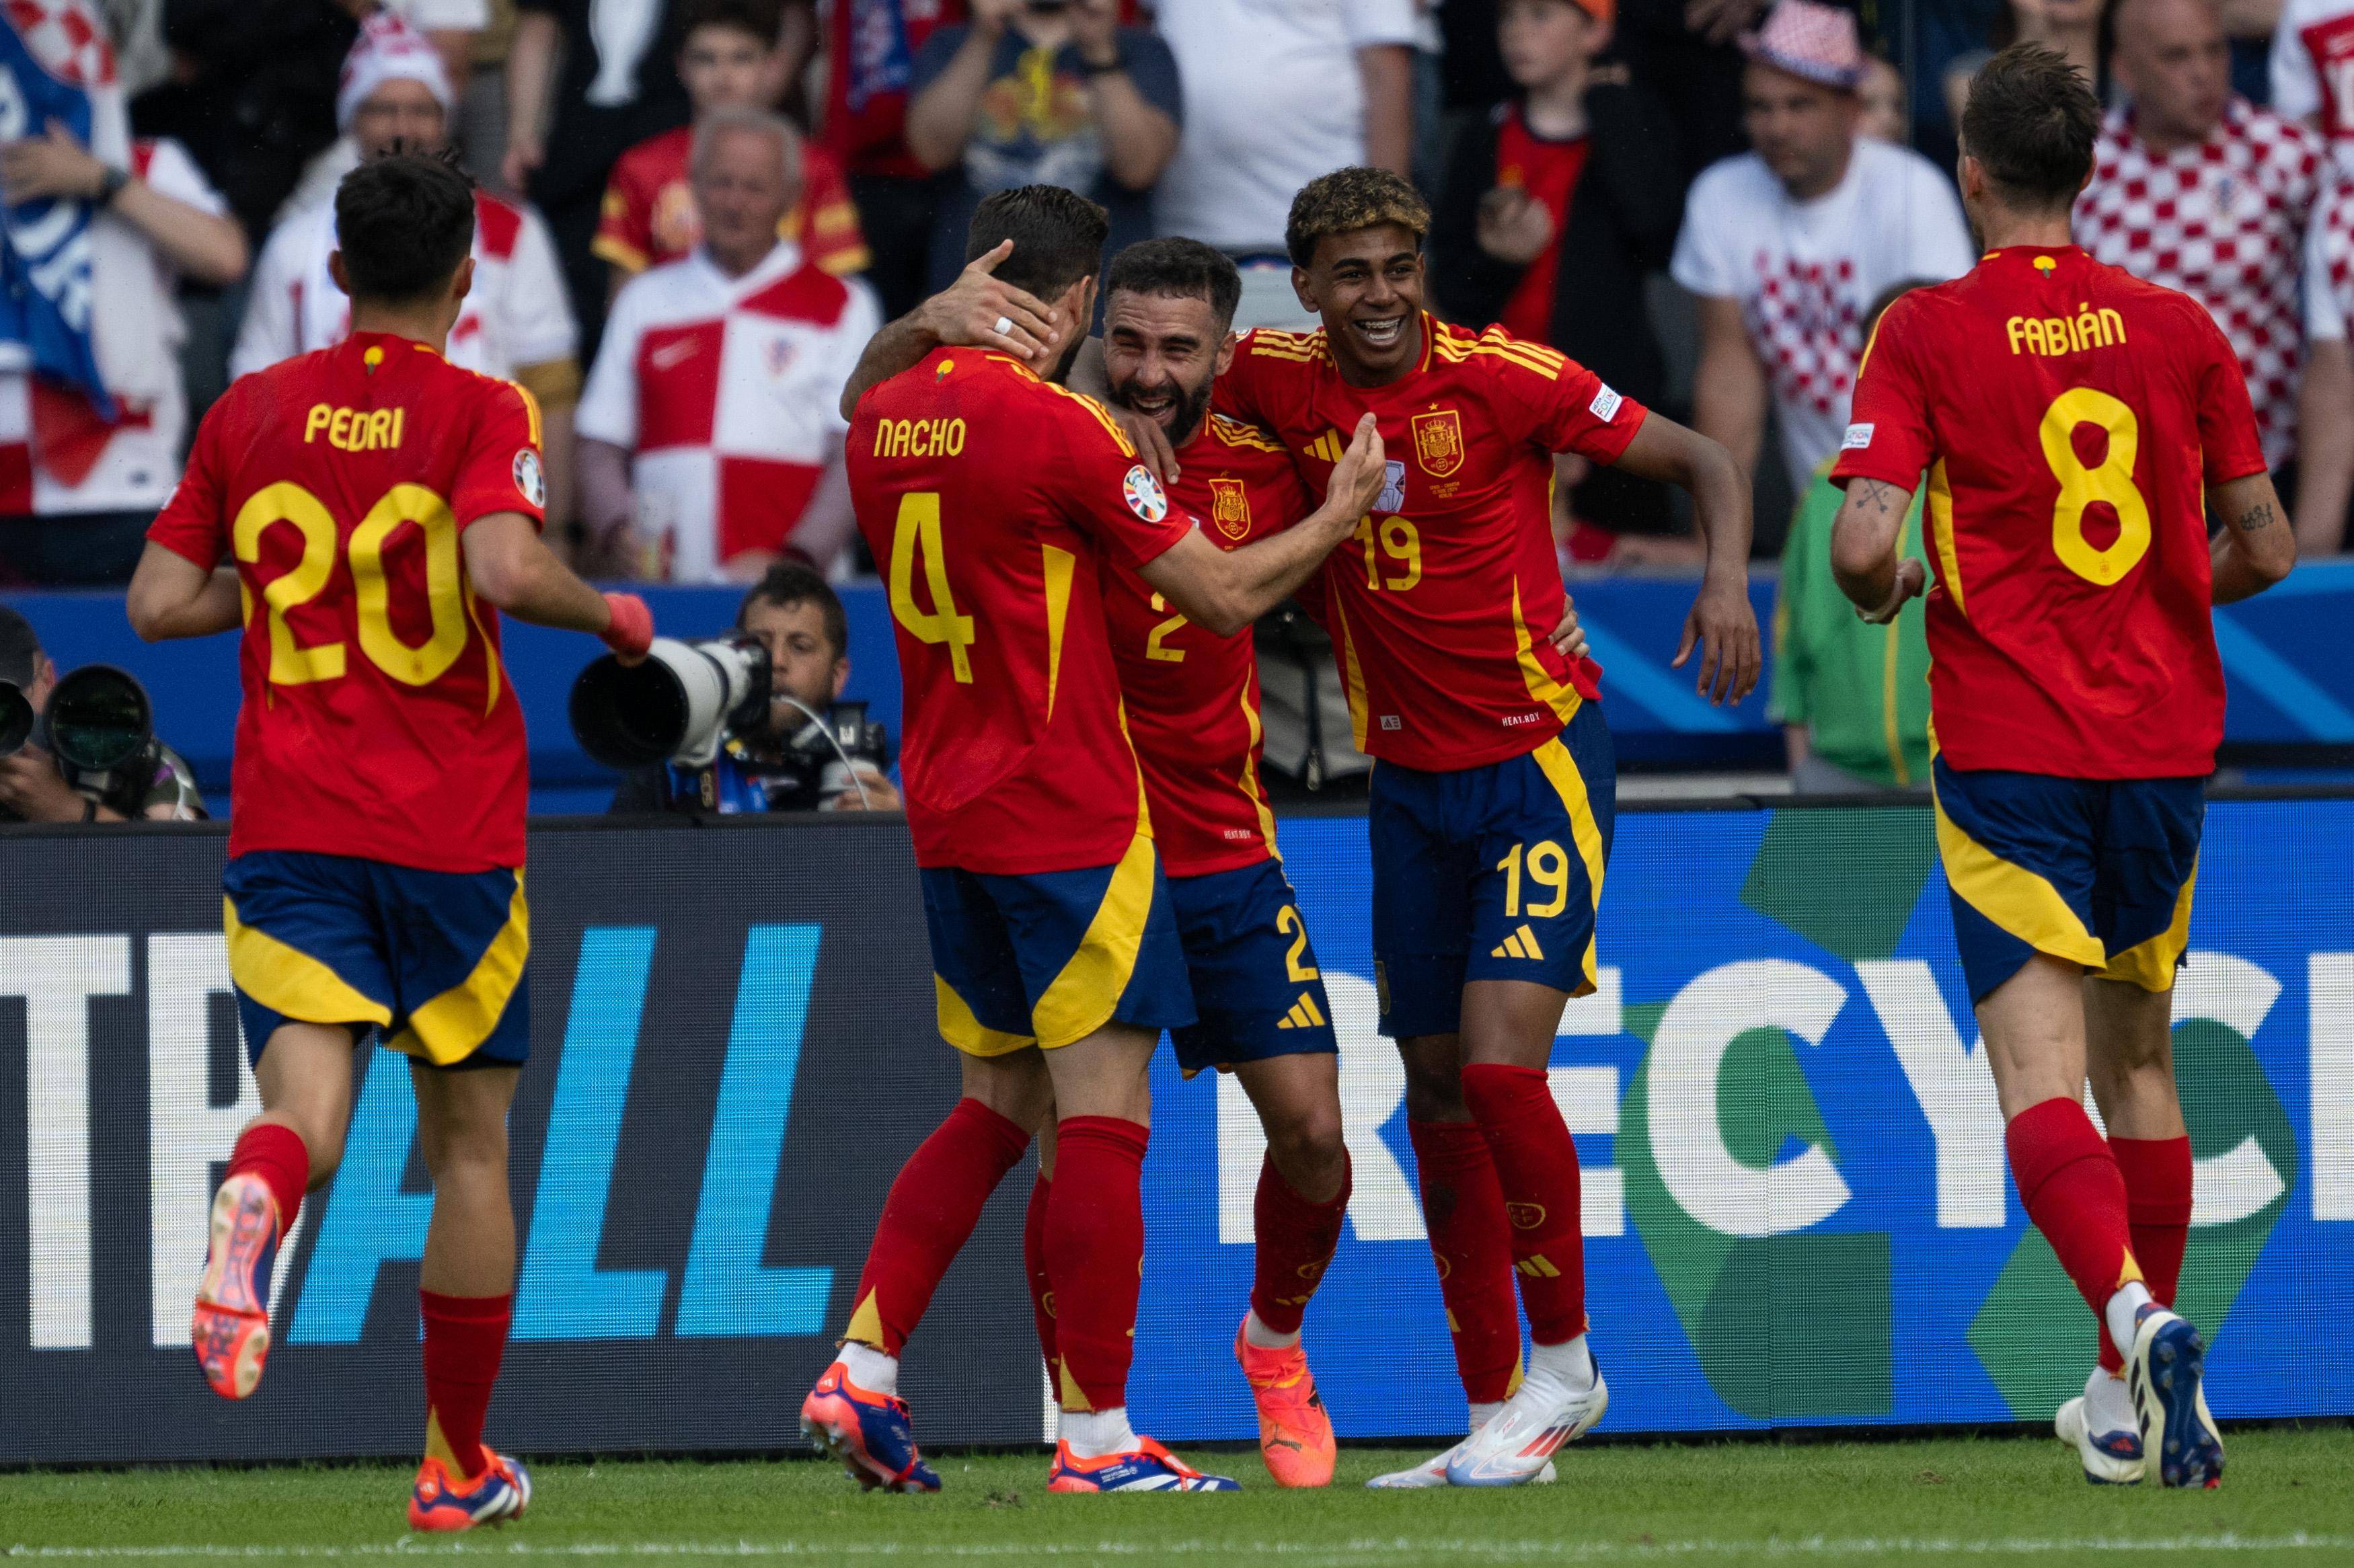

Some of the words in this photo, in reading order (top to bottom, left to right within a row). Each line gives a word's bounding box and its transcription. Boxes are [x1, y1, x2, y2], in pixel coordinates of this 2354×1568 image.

[2006, 302, 2127, 356] FABIÁN
[304, 403, 404, 451] PEDRI
[874, 418, 966, 457] NACHO
[2039, 386, 2152, 586] 8
[233, 480, 468, 686] 20
[890, 492, 975, 684] 4
[1353, 515, 1422, 592] 19
[1145, 591, 1189, 662] 2
[1502, 711, 1540, 727] HEAT.RDY
[1496, 840, 1568, 918] 19
[1275, 904, 1319, 983] 2
